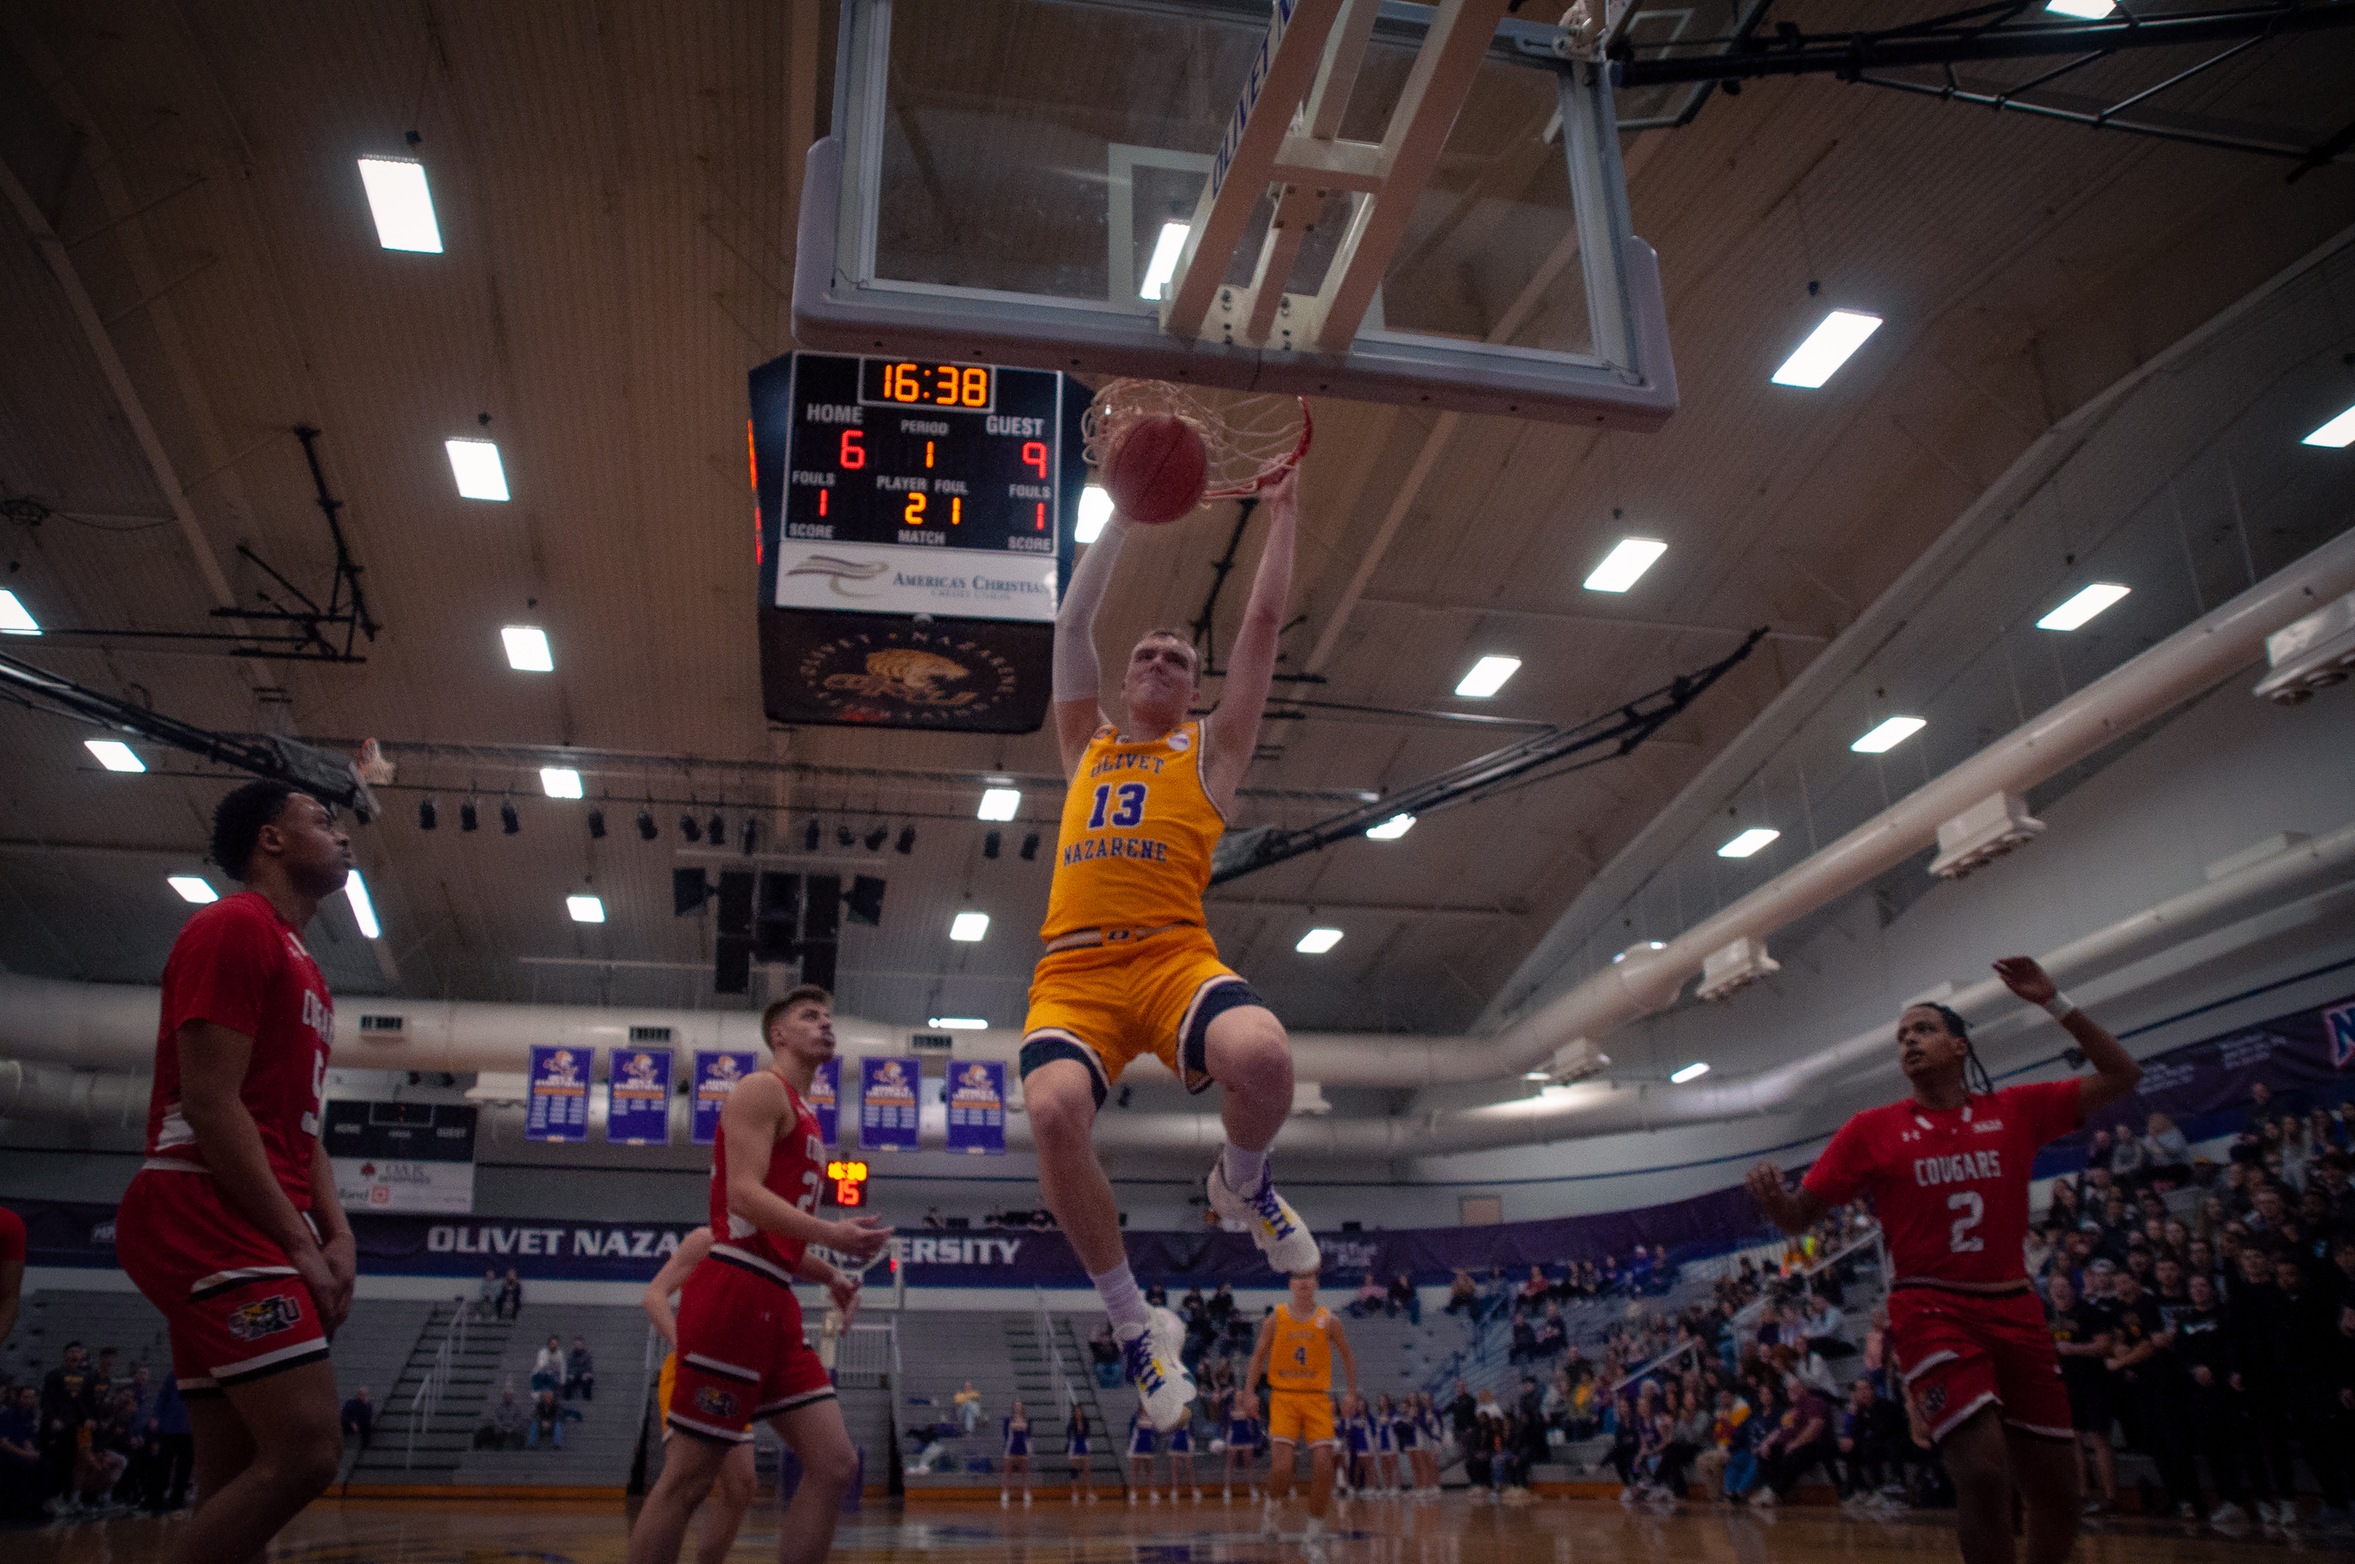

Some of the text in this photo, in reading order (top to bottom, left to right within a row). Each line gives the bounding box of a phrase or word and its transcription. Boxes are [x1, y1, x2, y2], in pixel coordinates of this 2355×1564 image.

[1212, 24, 1272, 201] OLIVET
[883, 363, 988, 407] 16:38
[806, 403, 864, 425] HOME
[900, 420, 949, 436] PERIOD
[985, 416, 1045, 437] GUEST
[839, 429, 866, 470] 6
[924, 440, 935, 469] 1
[1021, 441, 1047, 479] 9
[791, 470, 836, 488] FOULS
[876, 475, 969, 496] PLAYER FOUL
[1008, 483, 1051, 500] FOULS
[818, 488, 828, 517] 1
[1035, 501, 1045, 531] 1
[788, 522, 834, 540] SCORE
[897, 529, 946, 546] MATCH
[1007, 536, 1052, 552] SCORE
[1087, 781, 1149, 831] 13
[1063, 836, 1169, 867] NAZARENE
[1913, 1149, 2002, 1187] COUGARS
[836, 1178, 860, 1207] 15
[1947, 1190, 1985, 1253] 2
[427, 1225, 564, 1254] OLIVET
[573, 1229, 681, 1257] NAZA
[1293, 1345, 1306, 1366] 4
